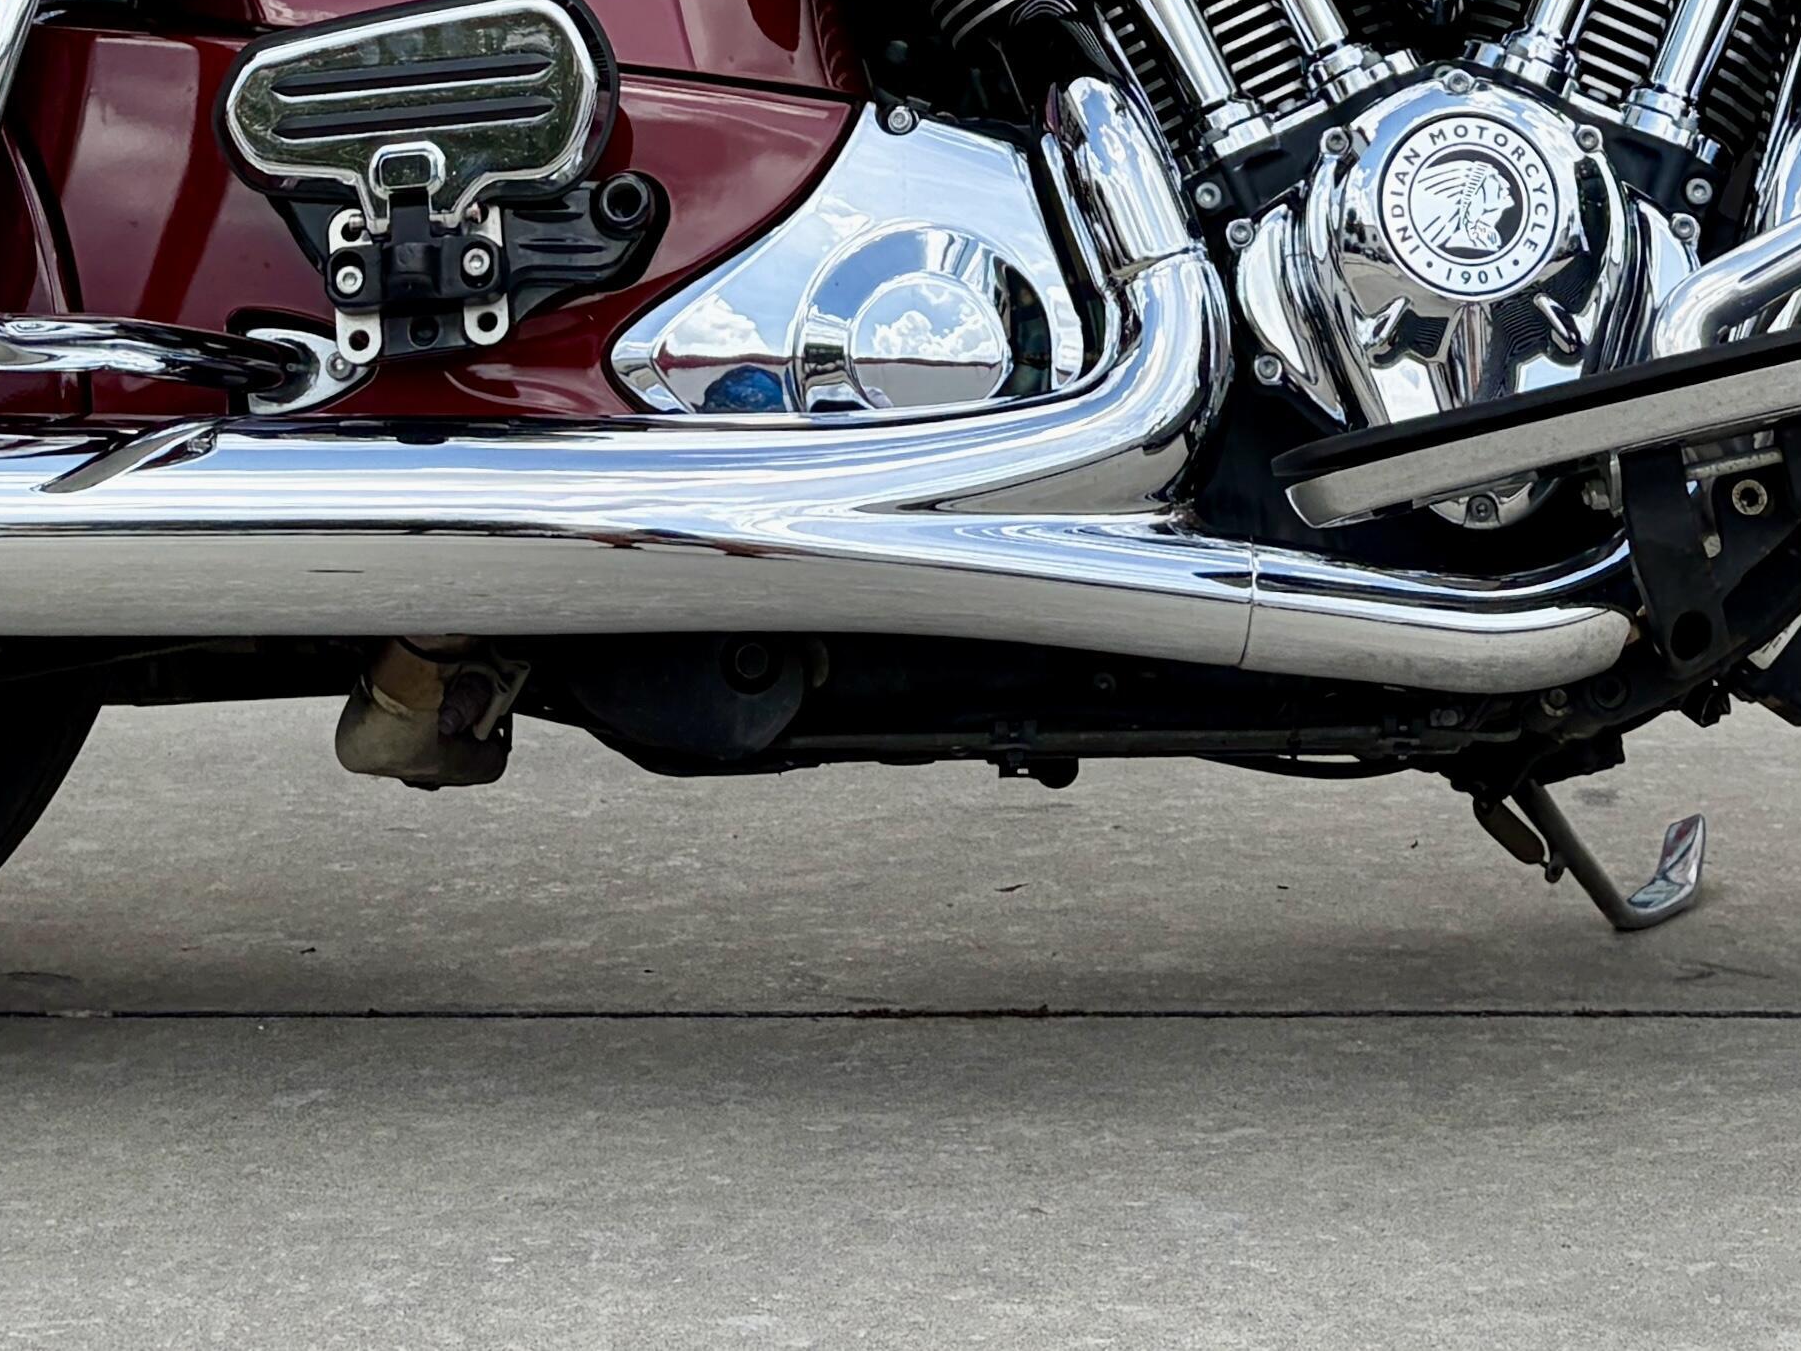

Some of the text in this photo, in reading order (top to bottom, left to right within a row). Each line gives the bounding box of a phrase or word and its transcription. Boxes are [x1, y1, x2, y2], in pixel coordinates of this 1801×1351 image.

[1390, 124, 1549, 256] INDIAN MOTORCYCLE
[1445, 265, 1504, 285] 1901
